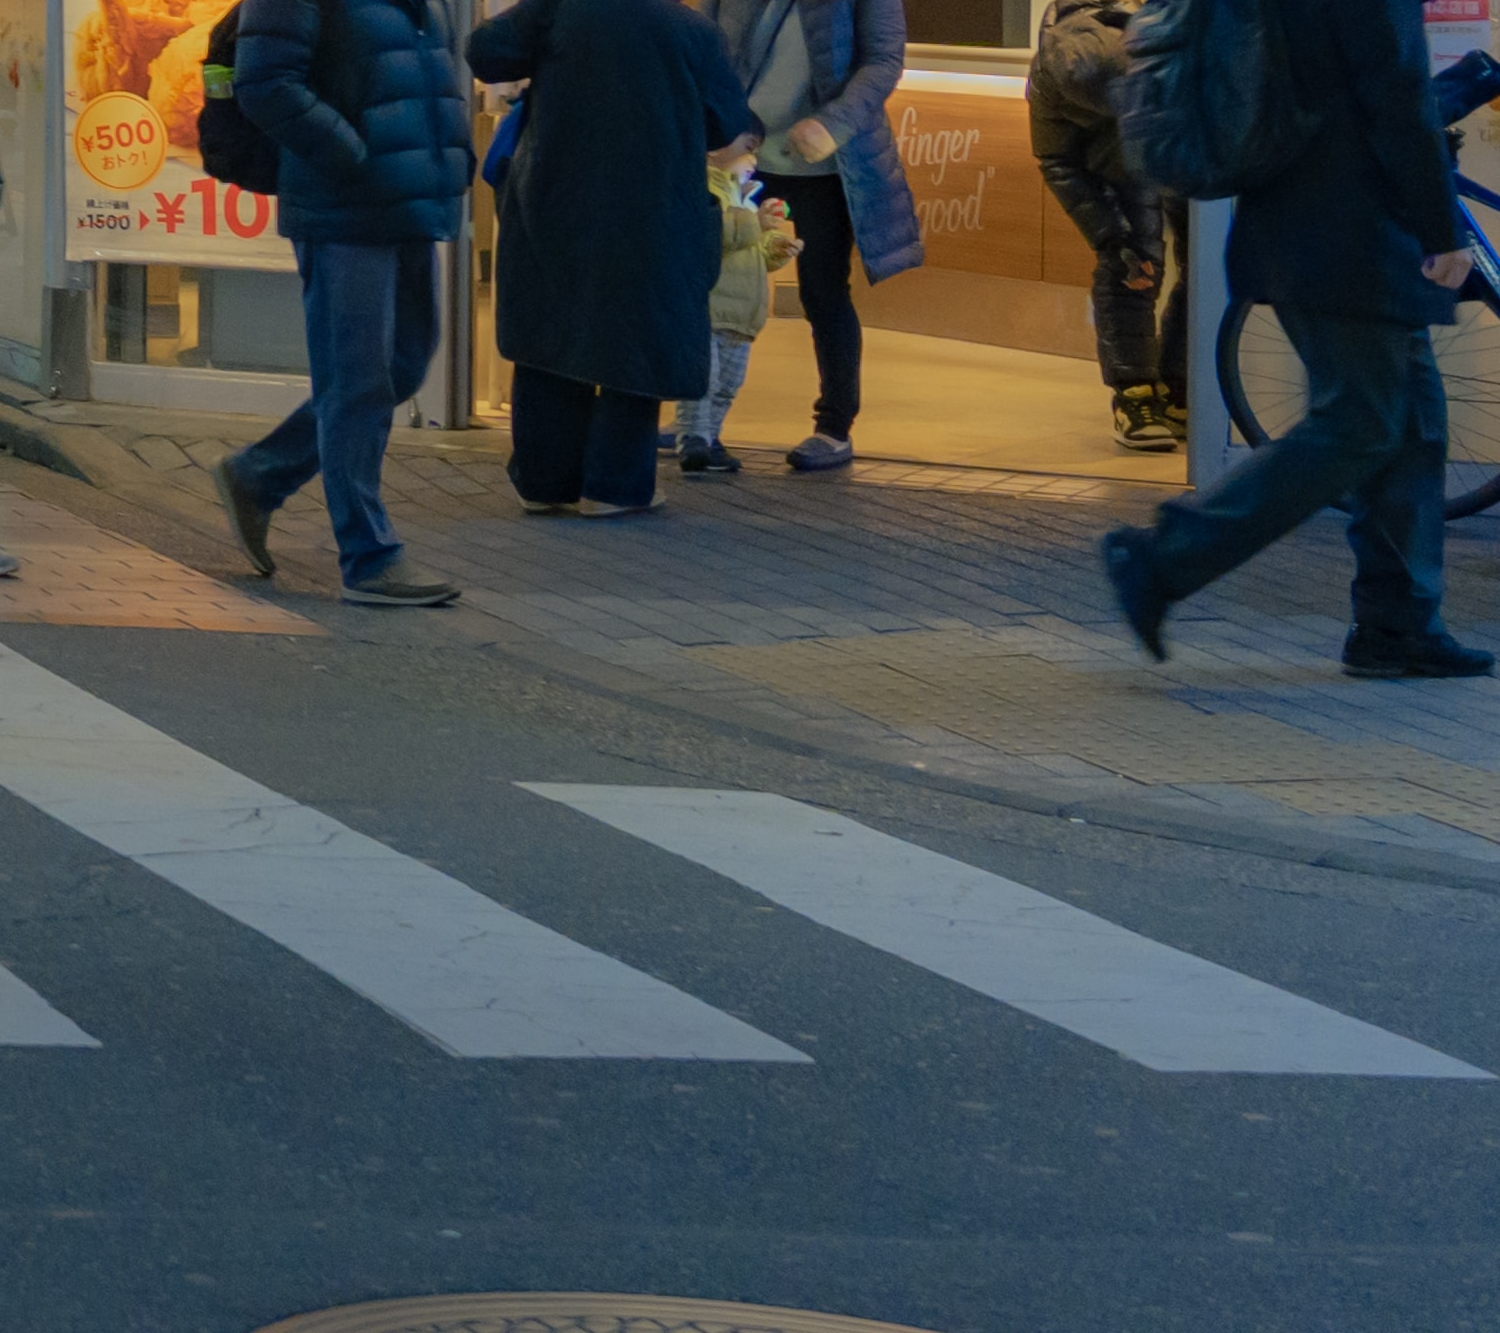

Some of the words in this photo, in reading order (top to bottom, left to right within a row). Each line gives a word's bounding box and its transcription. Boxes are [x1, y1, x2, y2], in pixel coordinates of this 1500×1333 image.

[81, 119, 156, 152] ¥500
[102, 150, 147, 171] おトク!
[153, 177, 278, 239] ¥10
